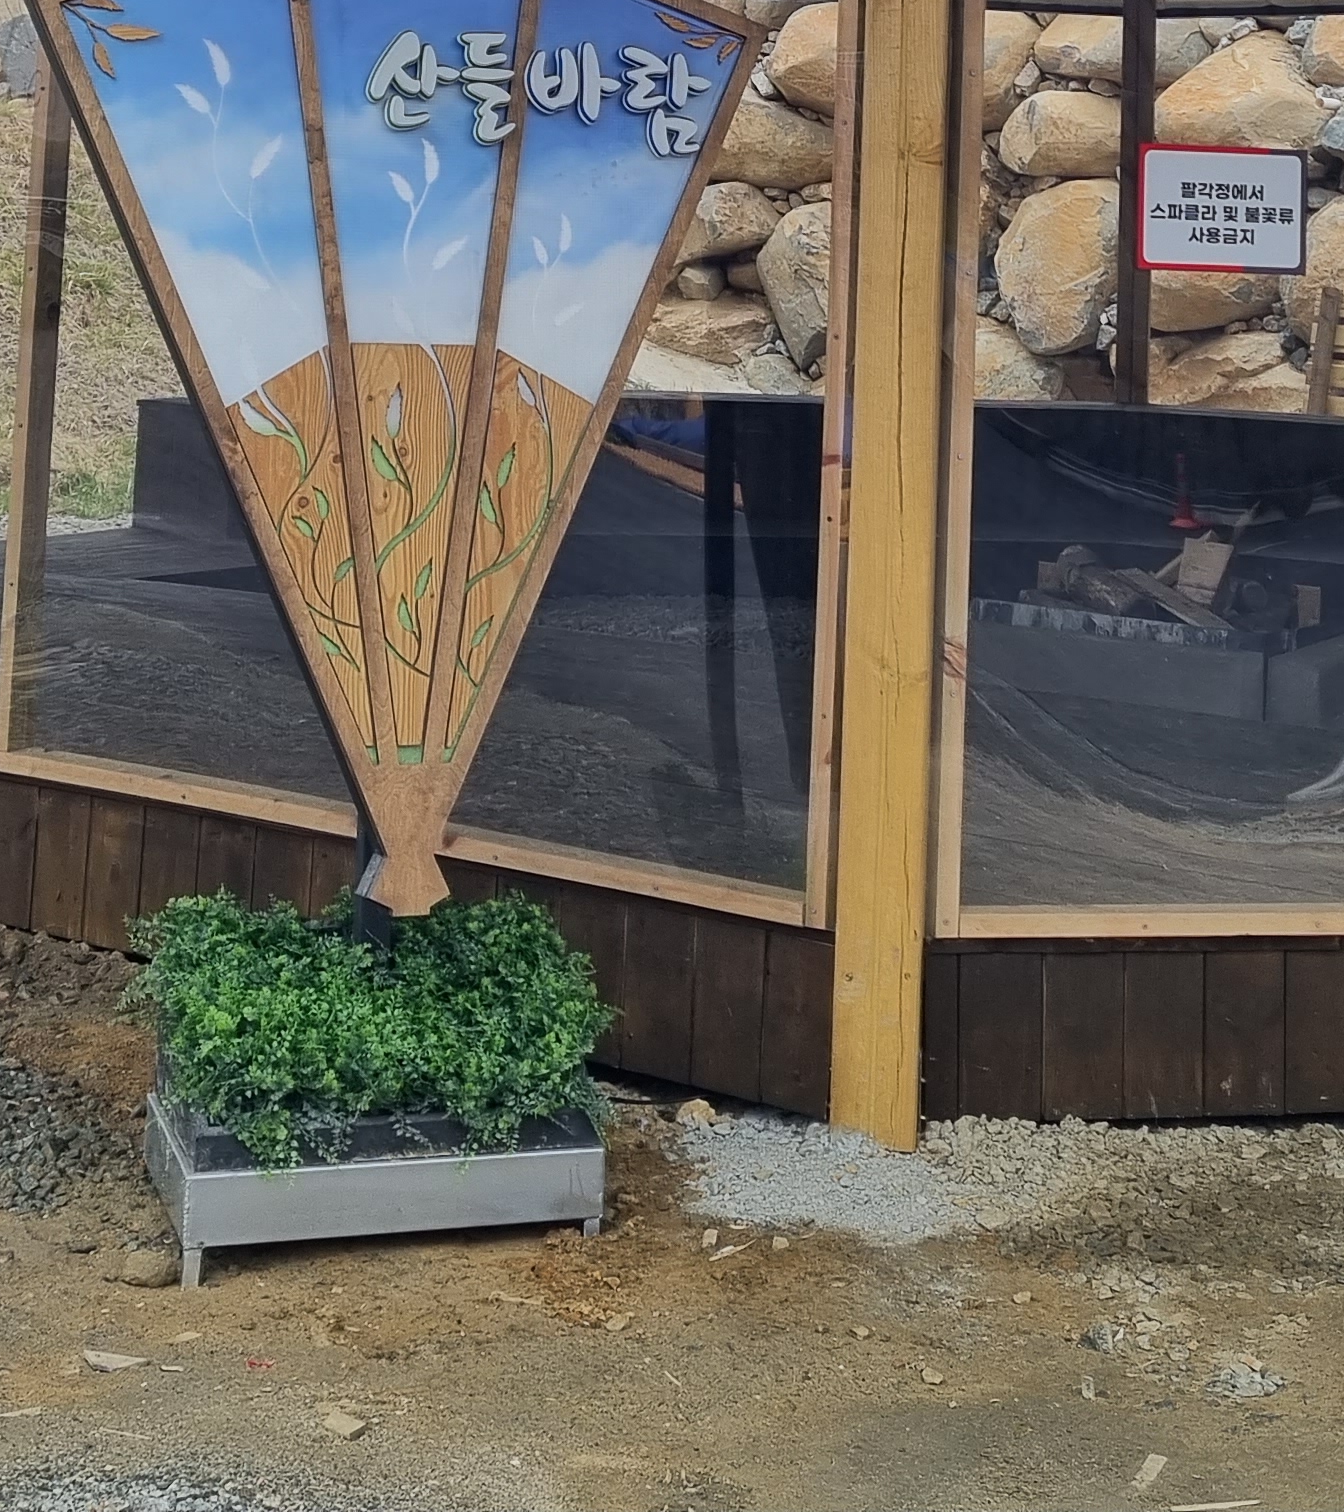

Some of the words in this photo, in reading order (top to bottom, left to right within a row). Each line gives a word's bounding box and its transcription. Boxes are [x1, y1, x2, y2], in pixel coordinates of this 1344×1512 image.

[365, 29, 712, 158] 산들바람
[1181, 181, 1264, 201] 팔각정에서
[1150, 203, 1217, 222] 스파클라
[1223, 206, 1238, 222] 및
[1245, 206, 1294, 225] 불꽃류
[1188, 227, 1255, 245] 사용금지
